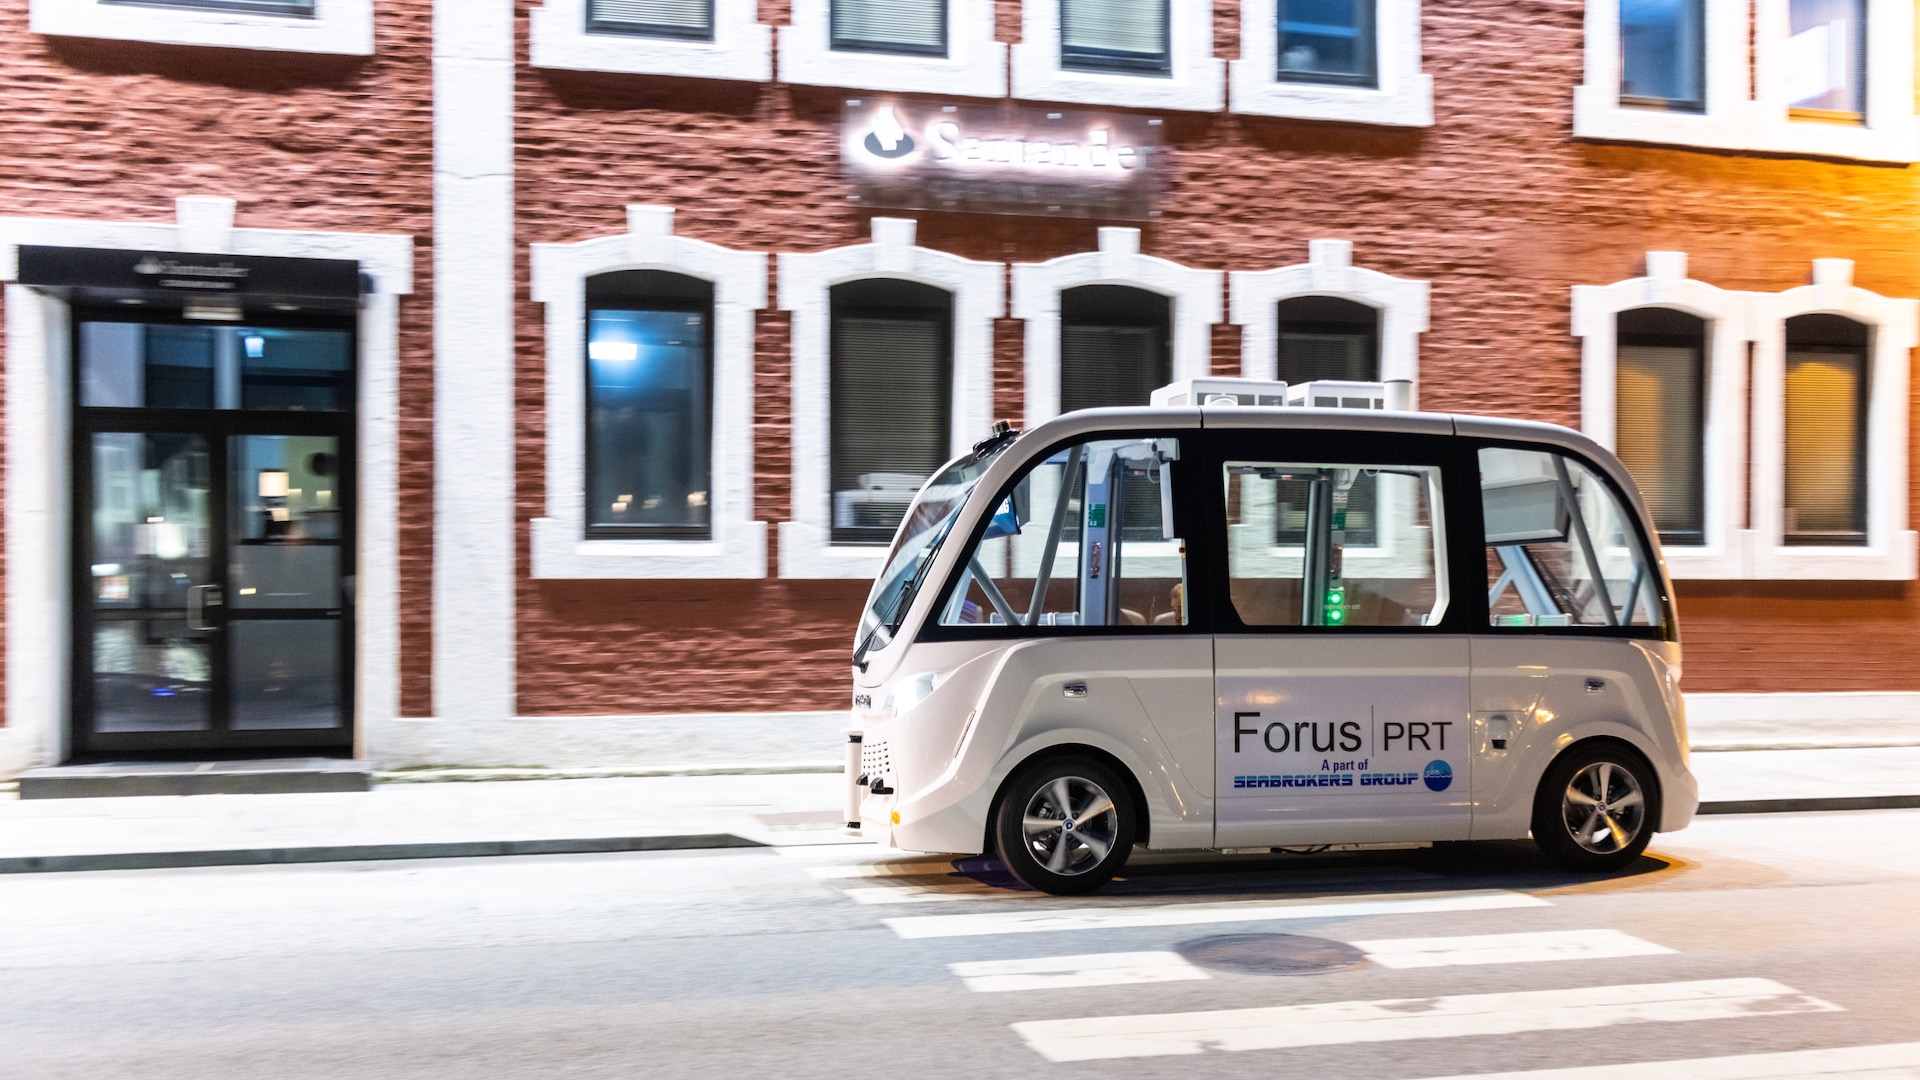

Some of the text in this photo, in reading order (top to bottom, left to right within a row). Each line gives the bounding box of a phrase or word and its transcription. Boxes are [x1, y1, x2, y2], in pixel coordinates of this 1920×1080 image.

[1234, 711, 1453, 753] Forus PRT
[1321, 758, 1369, 773] A part of
[1233, 772, 1419, 788] SEABROKERS GROUP
